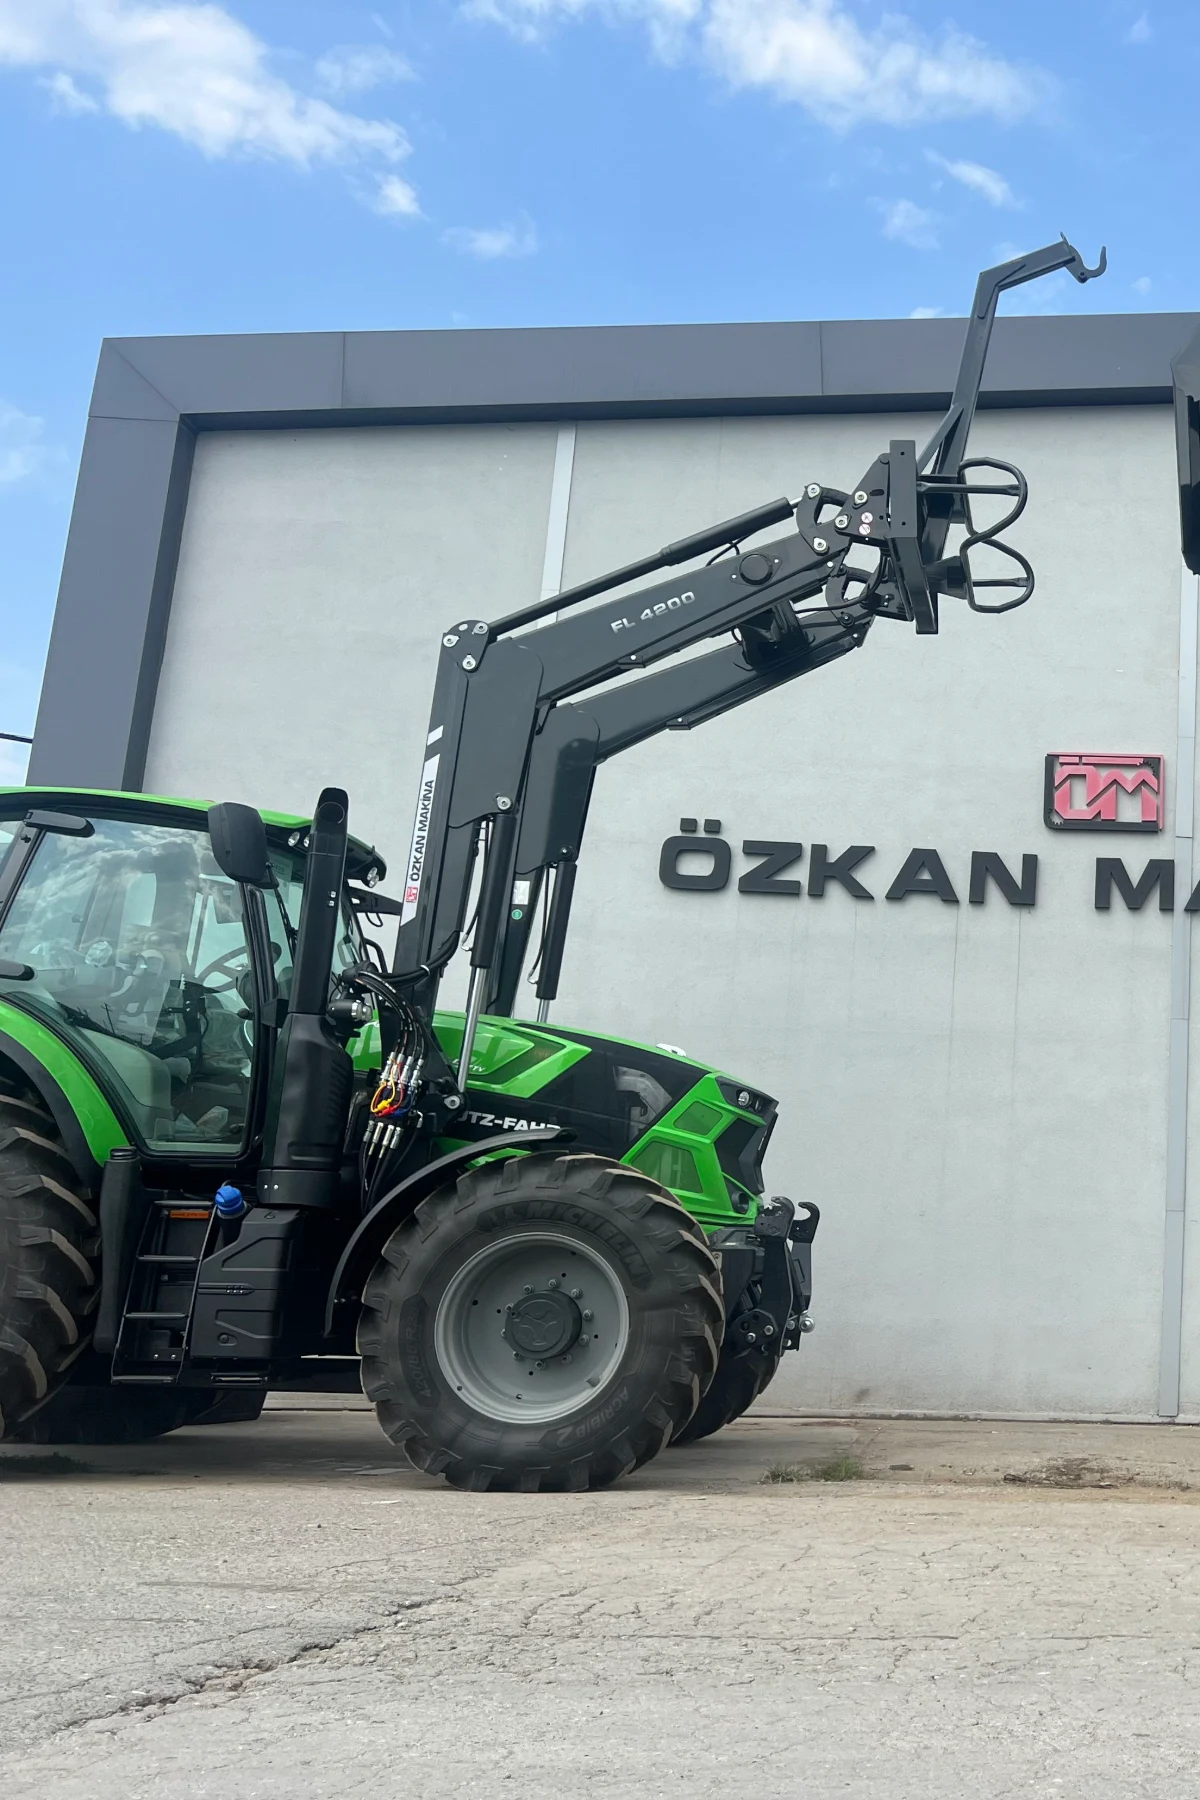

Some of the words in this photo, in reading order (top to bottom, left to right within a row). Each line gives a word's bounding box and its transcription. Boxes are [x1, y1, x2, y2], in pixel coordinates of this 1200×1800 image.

[610, 617, 636, 634] FL
[640, 591, 696, 621] 4200
[409, 834, 425, 882] ÖZKAN
[417, 779, 435, 832] MAKİNA
[658, 817, 1039, 906] ÖZKAN
[526, 1200, 652, 1279] MICHELIN
